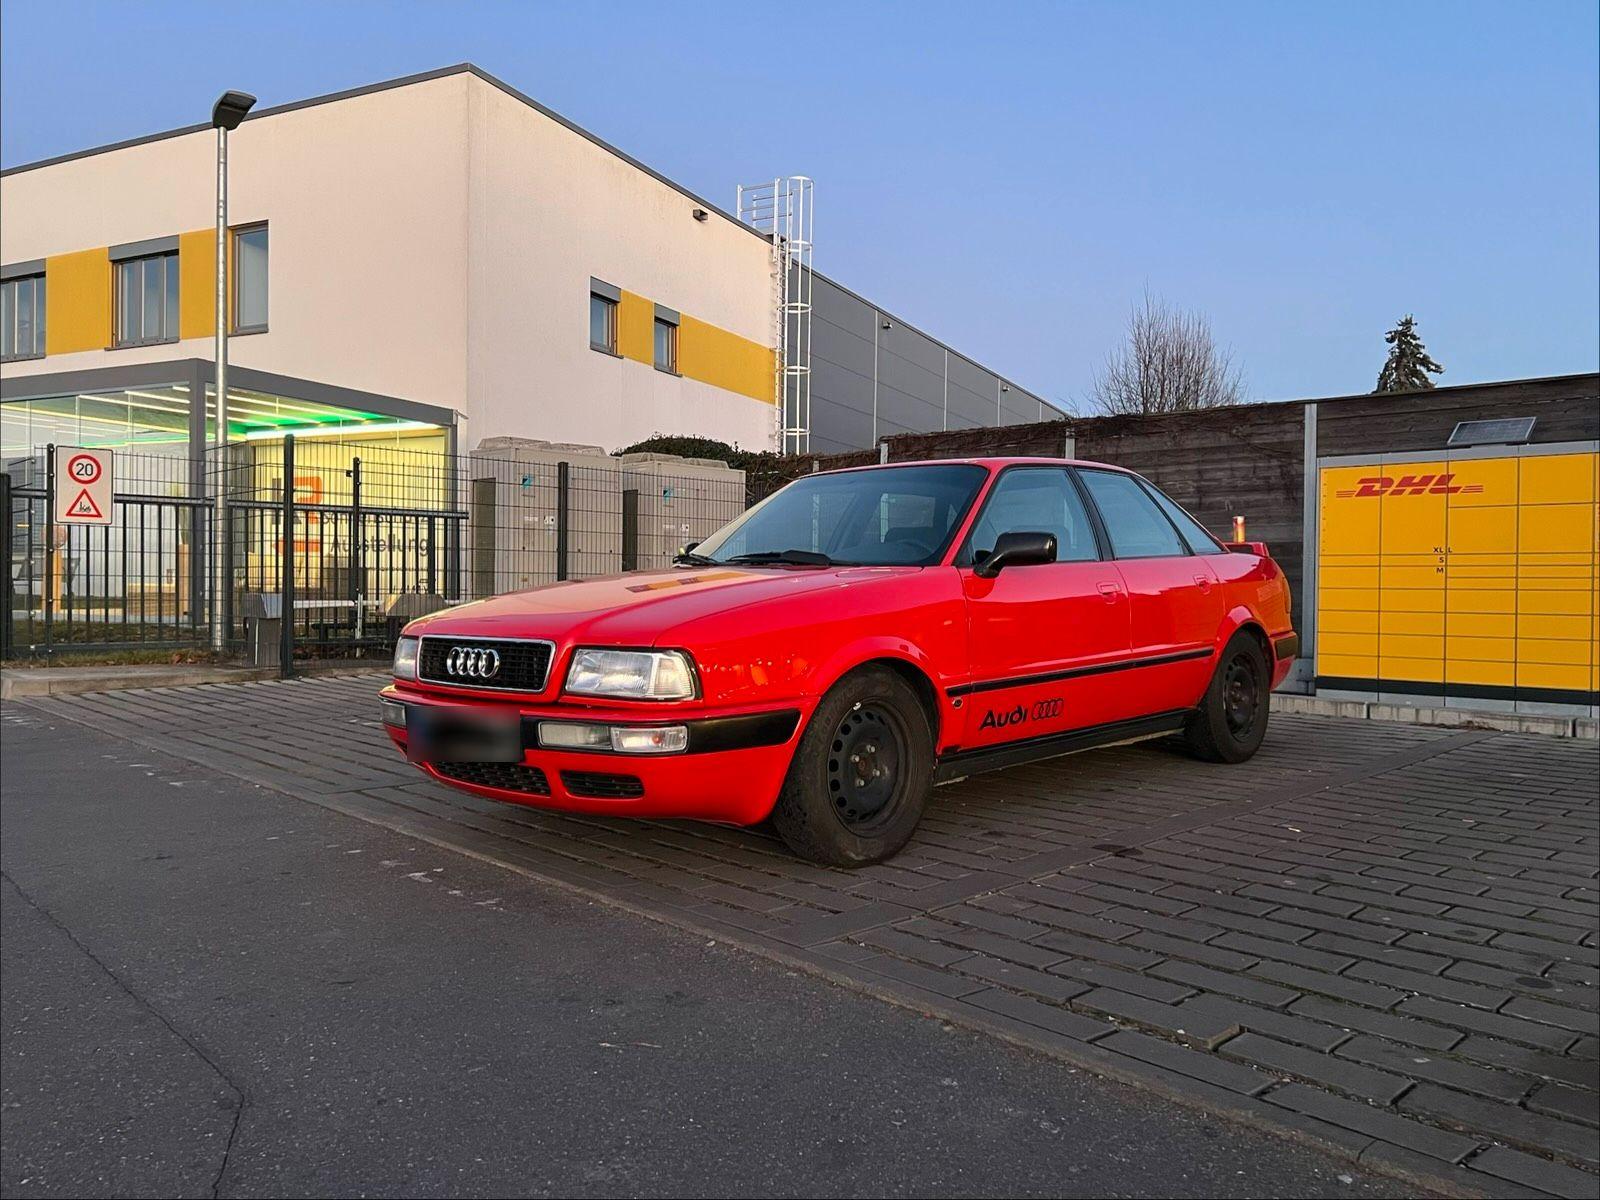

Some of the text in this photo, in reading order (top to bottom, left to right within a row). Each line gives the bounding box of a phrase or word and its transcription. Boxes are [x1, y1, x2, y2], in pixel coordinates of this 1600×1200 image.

[76, 463, 94, 476] 20
[1354, 474, 1462, 497] DHL
[1433, 546, 1444, 554] XL
[979, 705, 1028, 731] Audi
